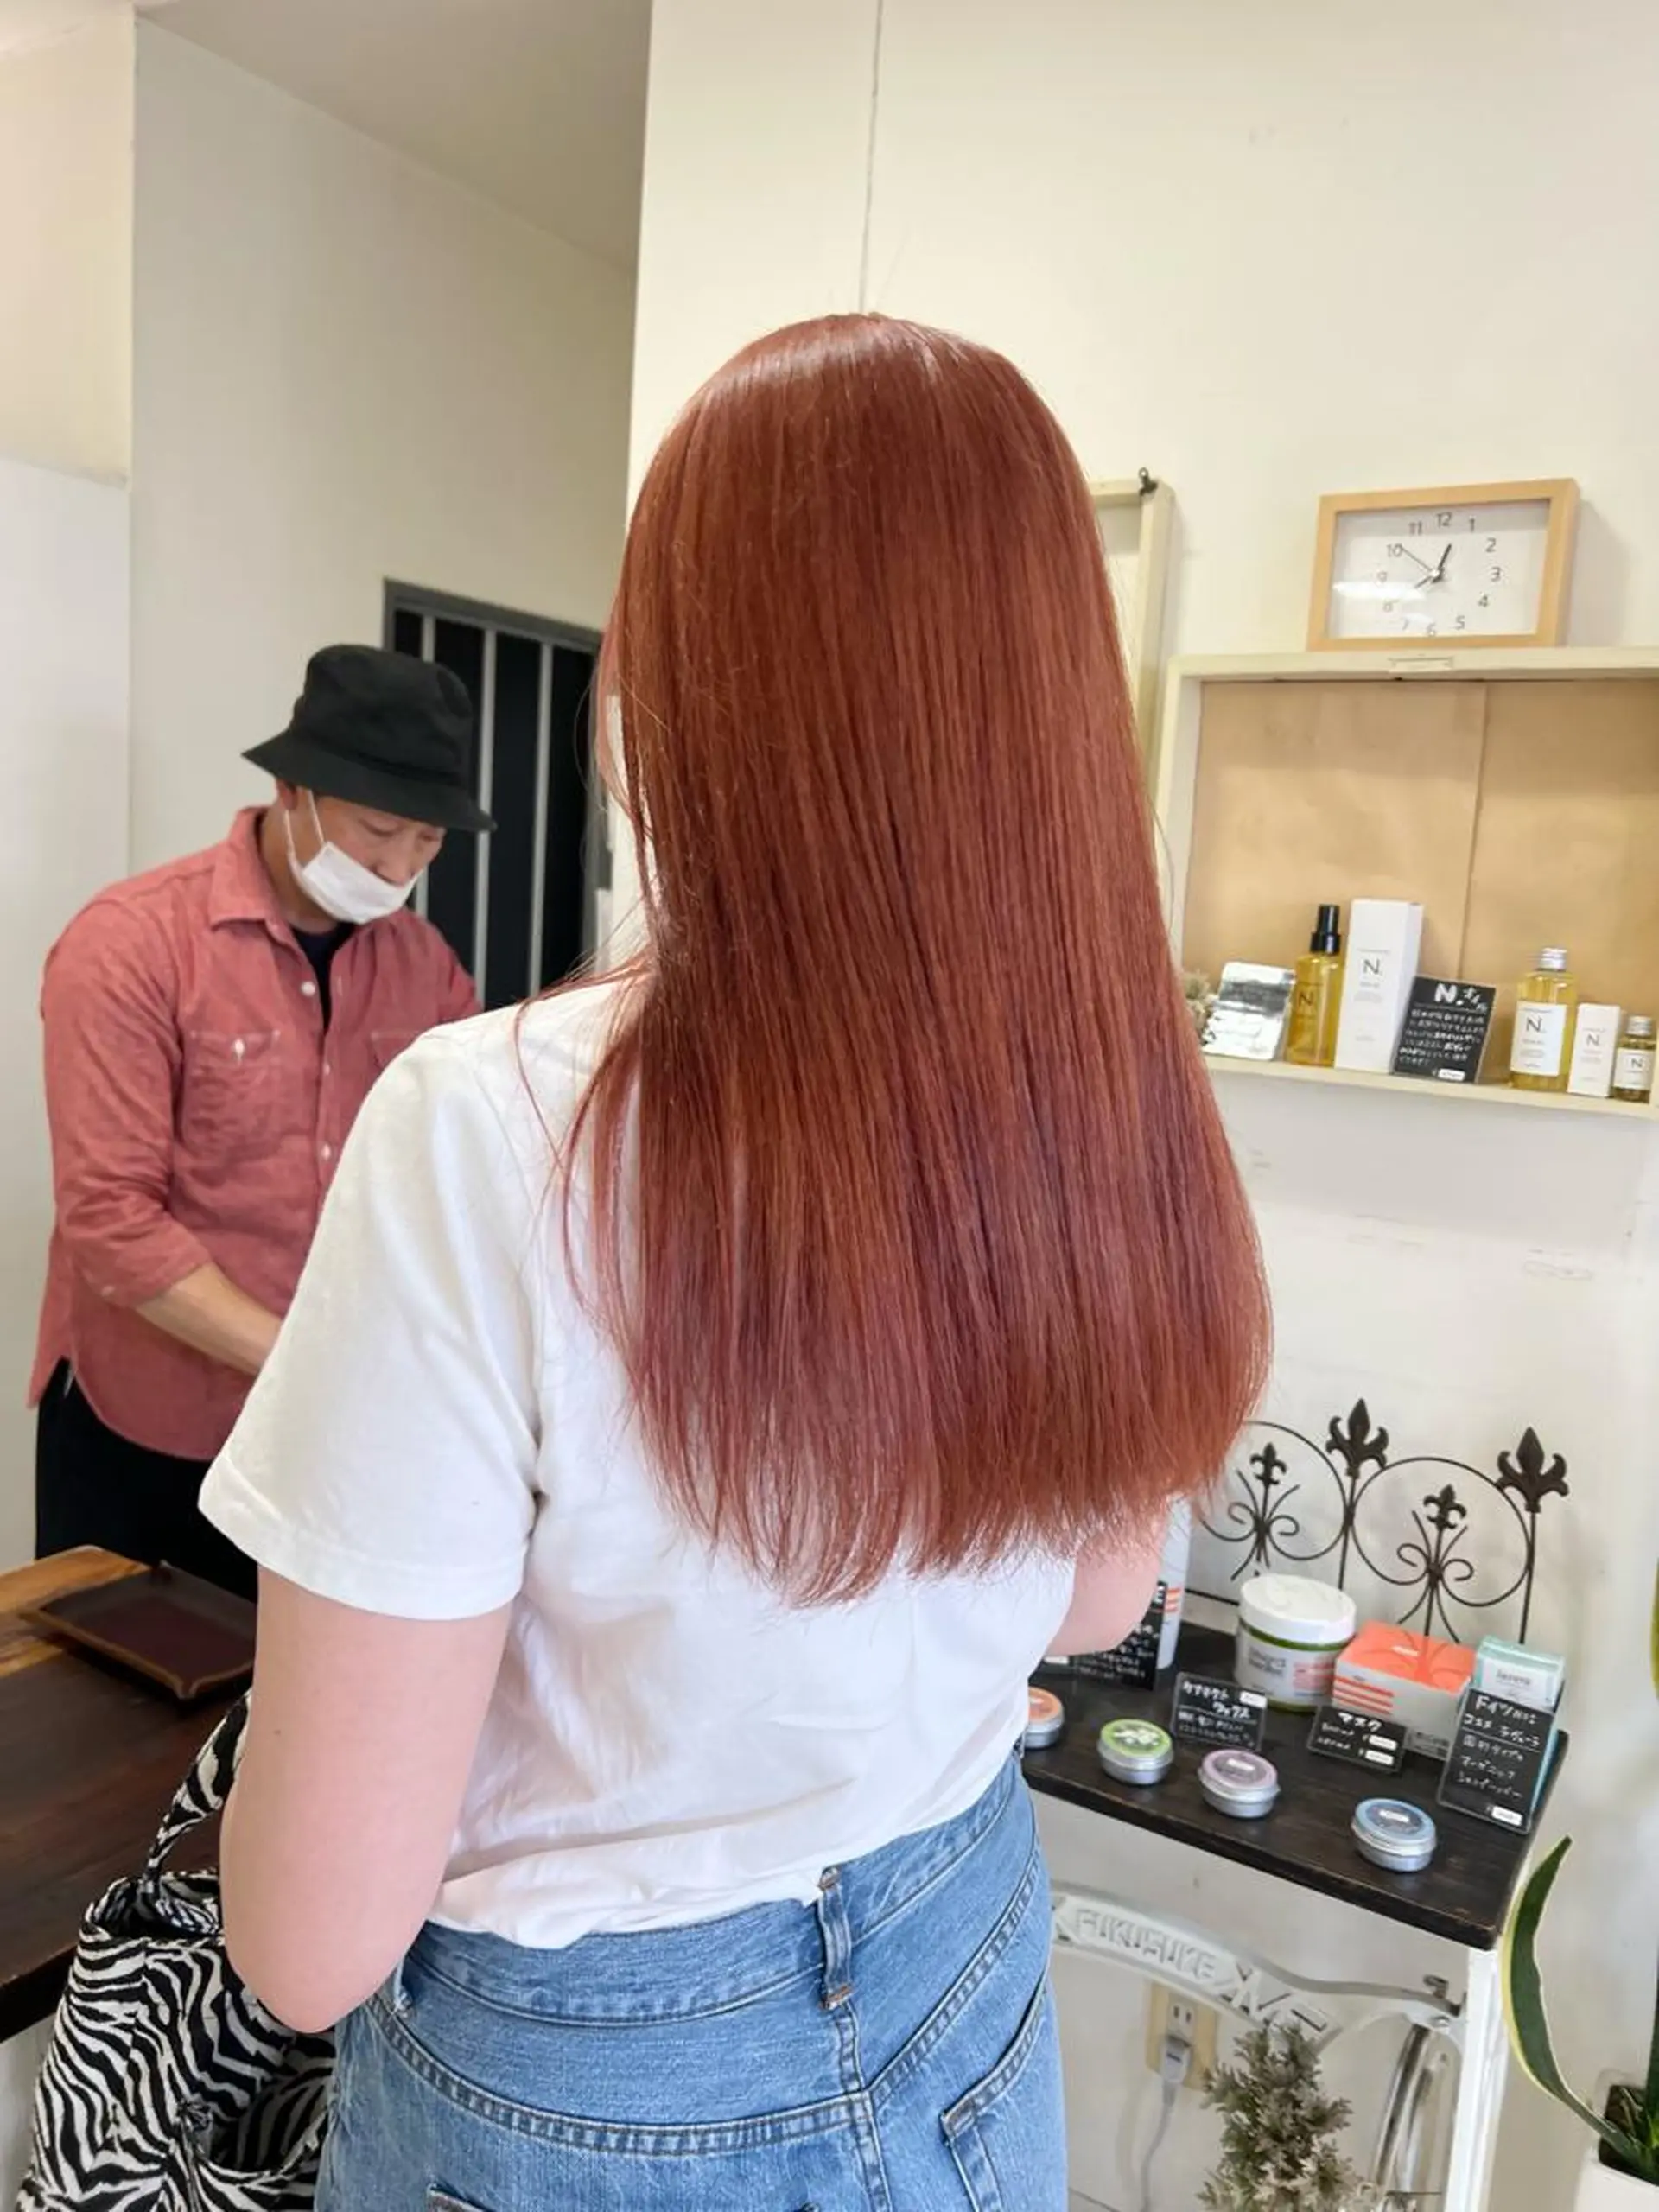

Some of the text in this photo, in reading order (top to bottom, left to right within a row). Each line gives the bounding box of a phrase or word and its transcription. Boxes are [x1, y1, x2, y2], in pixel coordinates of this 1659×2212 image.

[1437, 512, 1452, 528] 12
[1468, 518, 1476, 532] 1
[1408, 521, 1423, 536] 11
[1386, 543, 1402, 557] 10
[1485, 537, 1497, 553] 2
[1491, 566, 1502, 582] 3
[1478, 591, 1489, 607] 4
[1455, 614, 1465, 630] 5
[1434, 983, 1465, 1006] N.
[1338, 1712, 1382, 1732] マスク
[1077, 1908, 1217, 1979] FUKUSUKE
